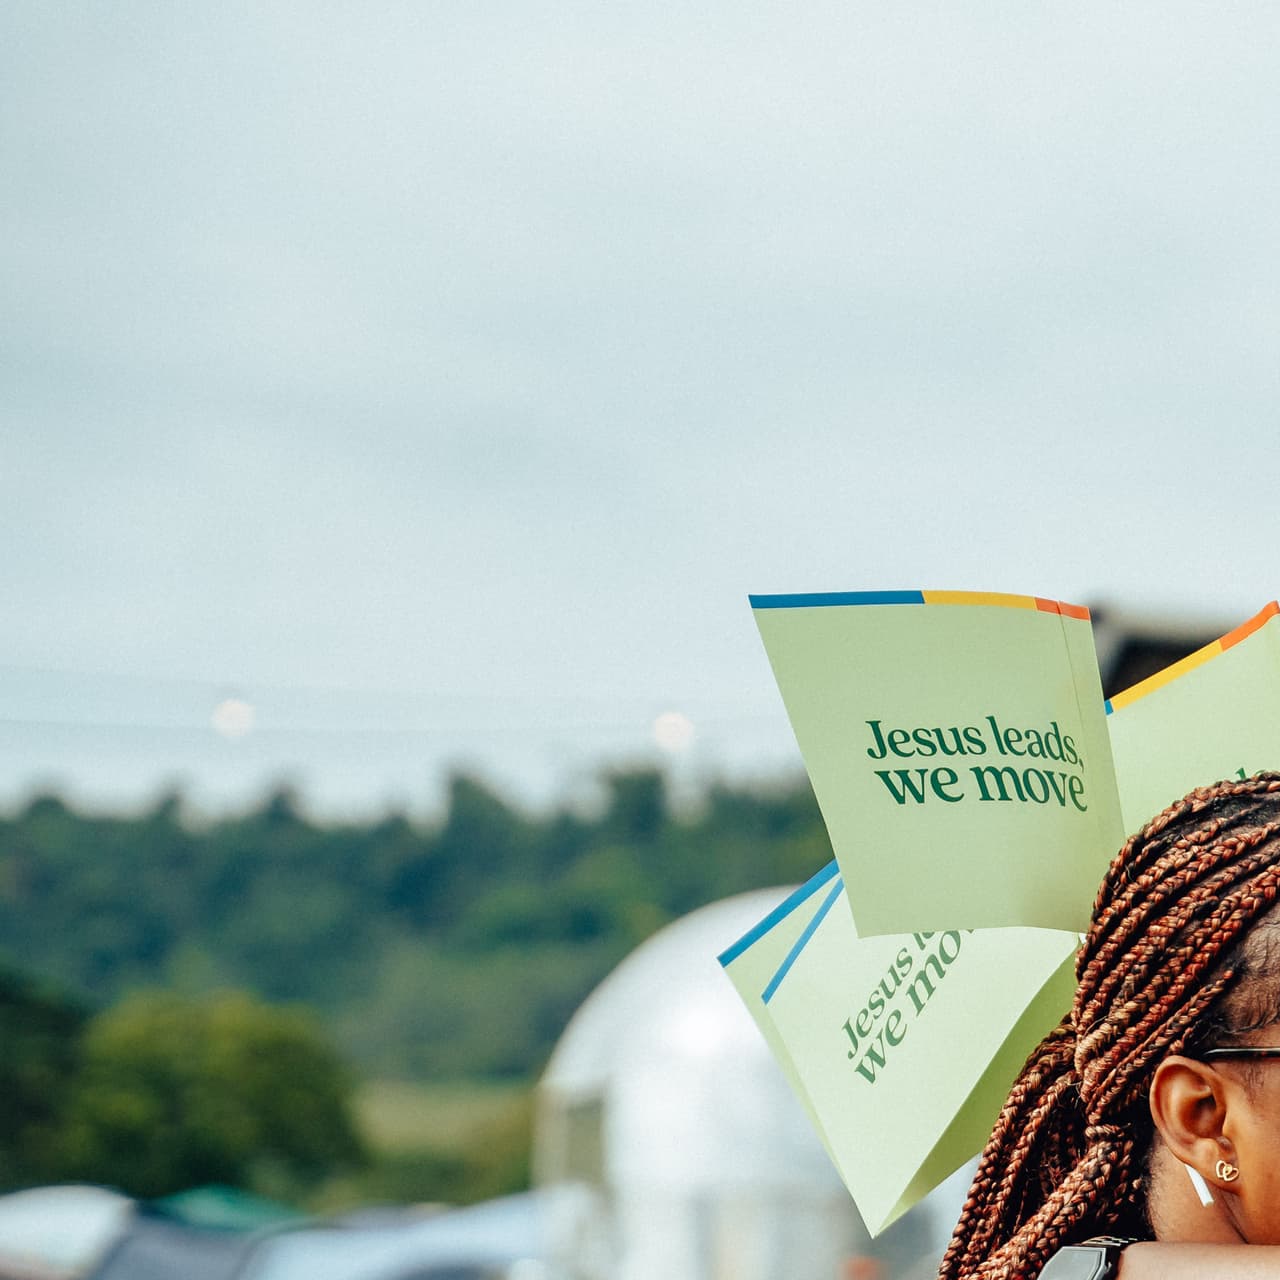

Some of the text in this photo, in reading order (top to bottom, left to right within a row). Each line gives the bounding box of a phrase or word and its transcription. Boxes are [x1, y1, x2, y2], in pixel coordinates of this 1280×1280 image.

[865, 715, 1085, 773] Jesus leads,
[874, 765, 1088, 812] we move
[842, 947, 913, 1060] Jesus
[854, 1009, 907, 1085] we
[906, 929, 975, 1018] mo
